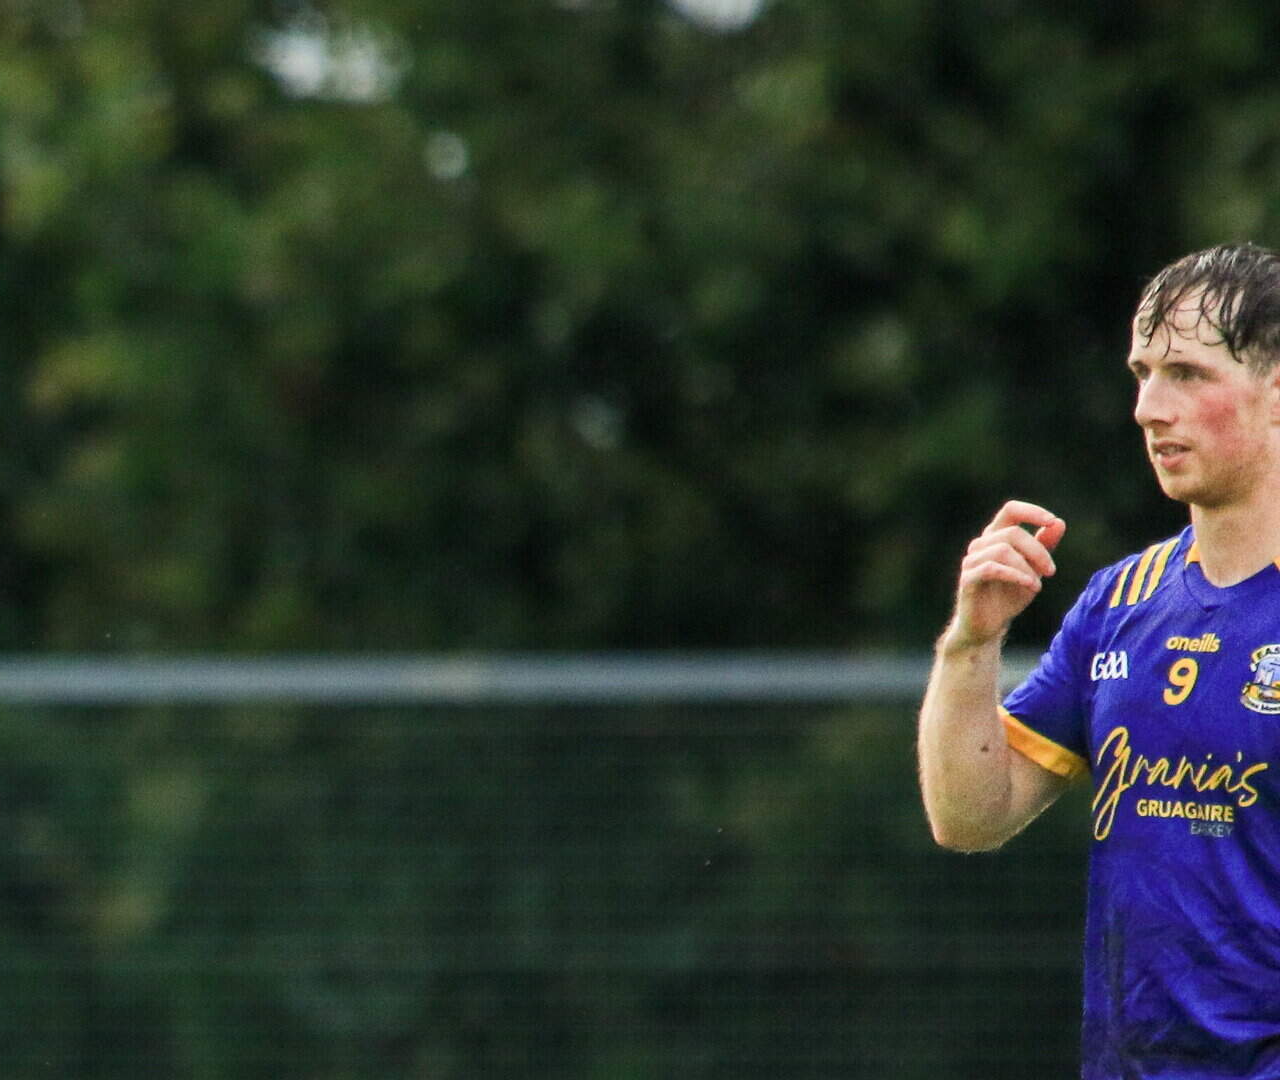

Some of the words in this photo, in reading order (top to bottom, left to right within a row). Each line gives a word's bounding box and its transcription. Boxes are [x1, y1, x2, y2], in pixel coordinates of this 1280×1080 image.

[1166, 633, 1221, 653] oneills
[1090, 650, 1129, 681] GAA
[1163, 657, 1199, 706] 9
[1136, 798, 1235, 823] GRUAGAIRE
